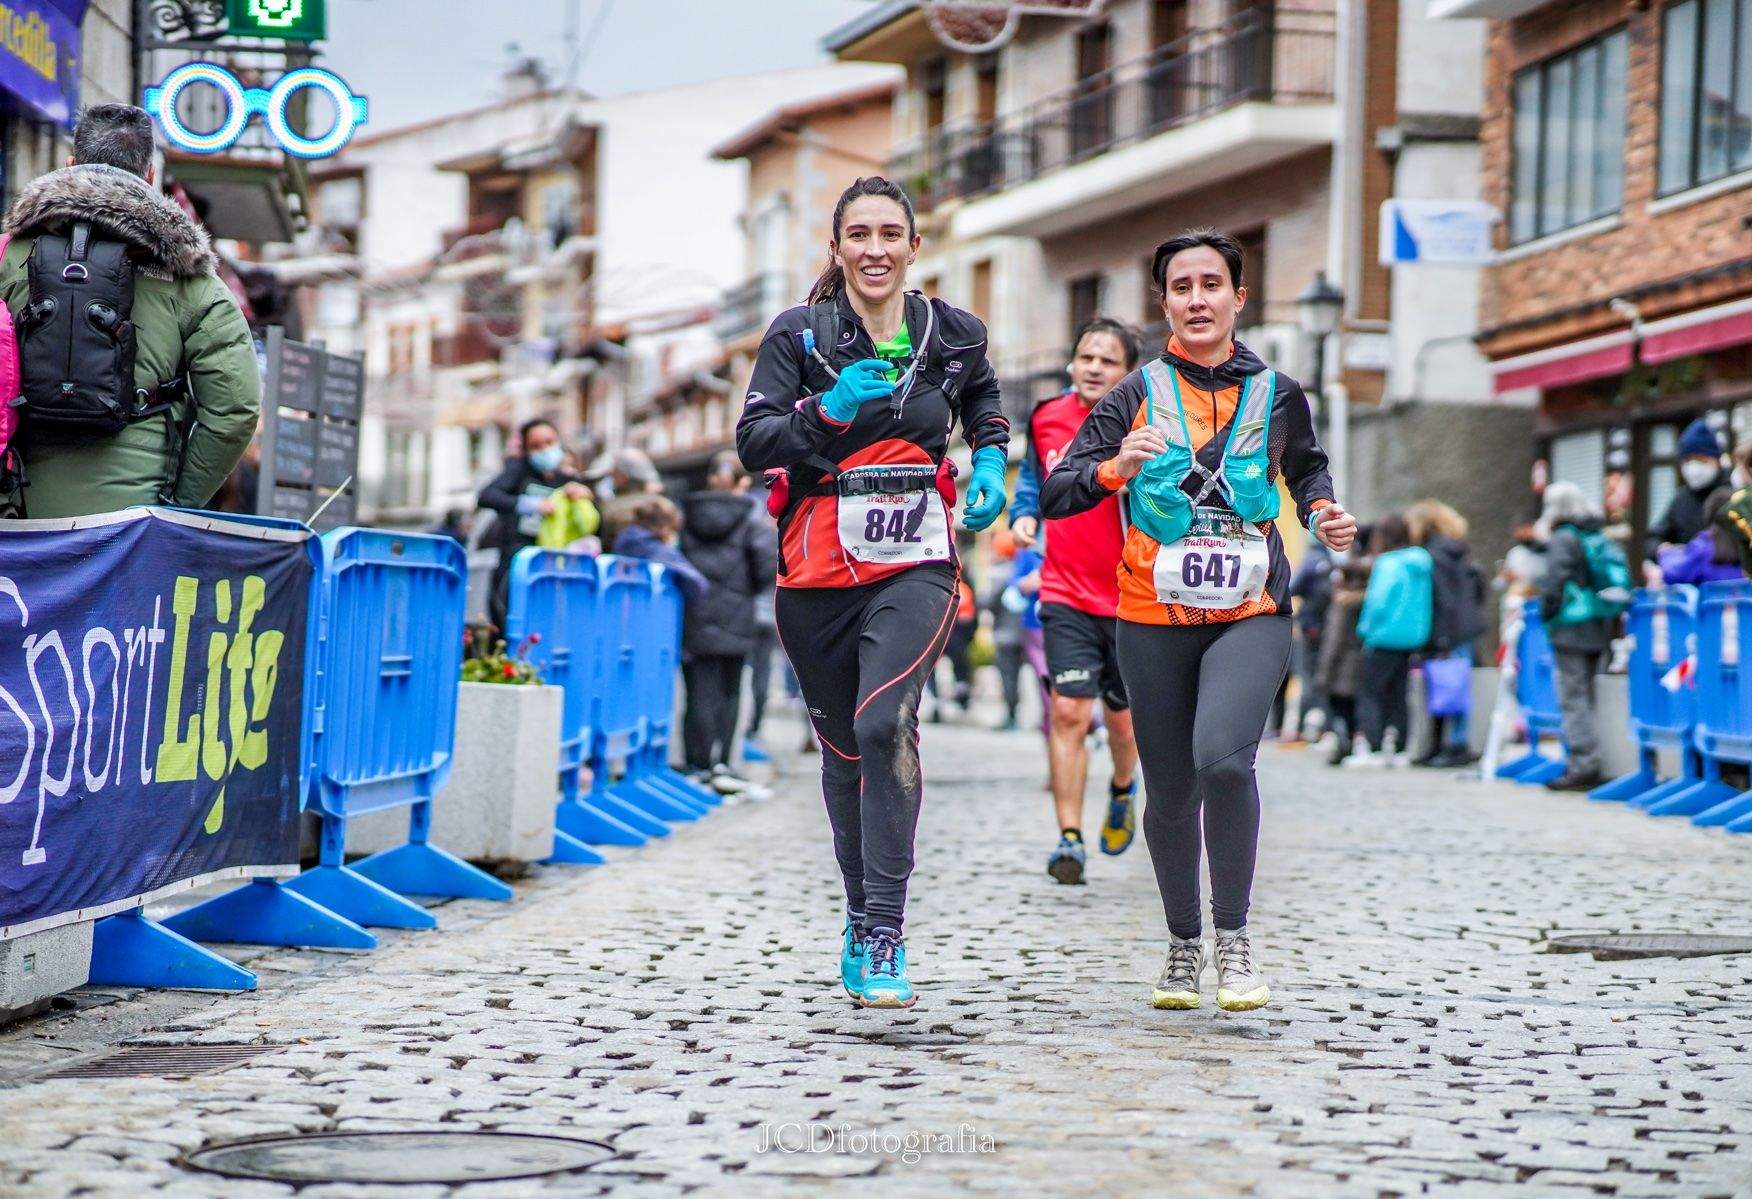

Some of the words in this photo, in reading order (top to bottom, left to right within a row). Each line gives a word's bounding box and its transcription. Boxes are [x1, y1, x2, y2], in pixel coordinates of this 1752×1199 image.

[865, 508, 921, 542] 842
[1208, 512, 1241, 523] NAVIDAD
[1182, 552, 1241, 588] 647
